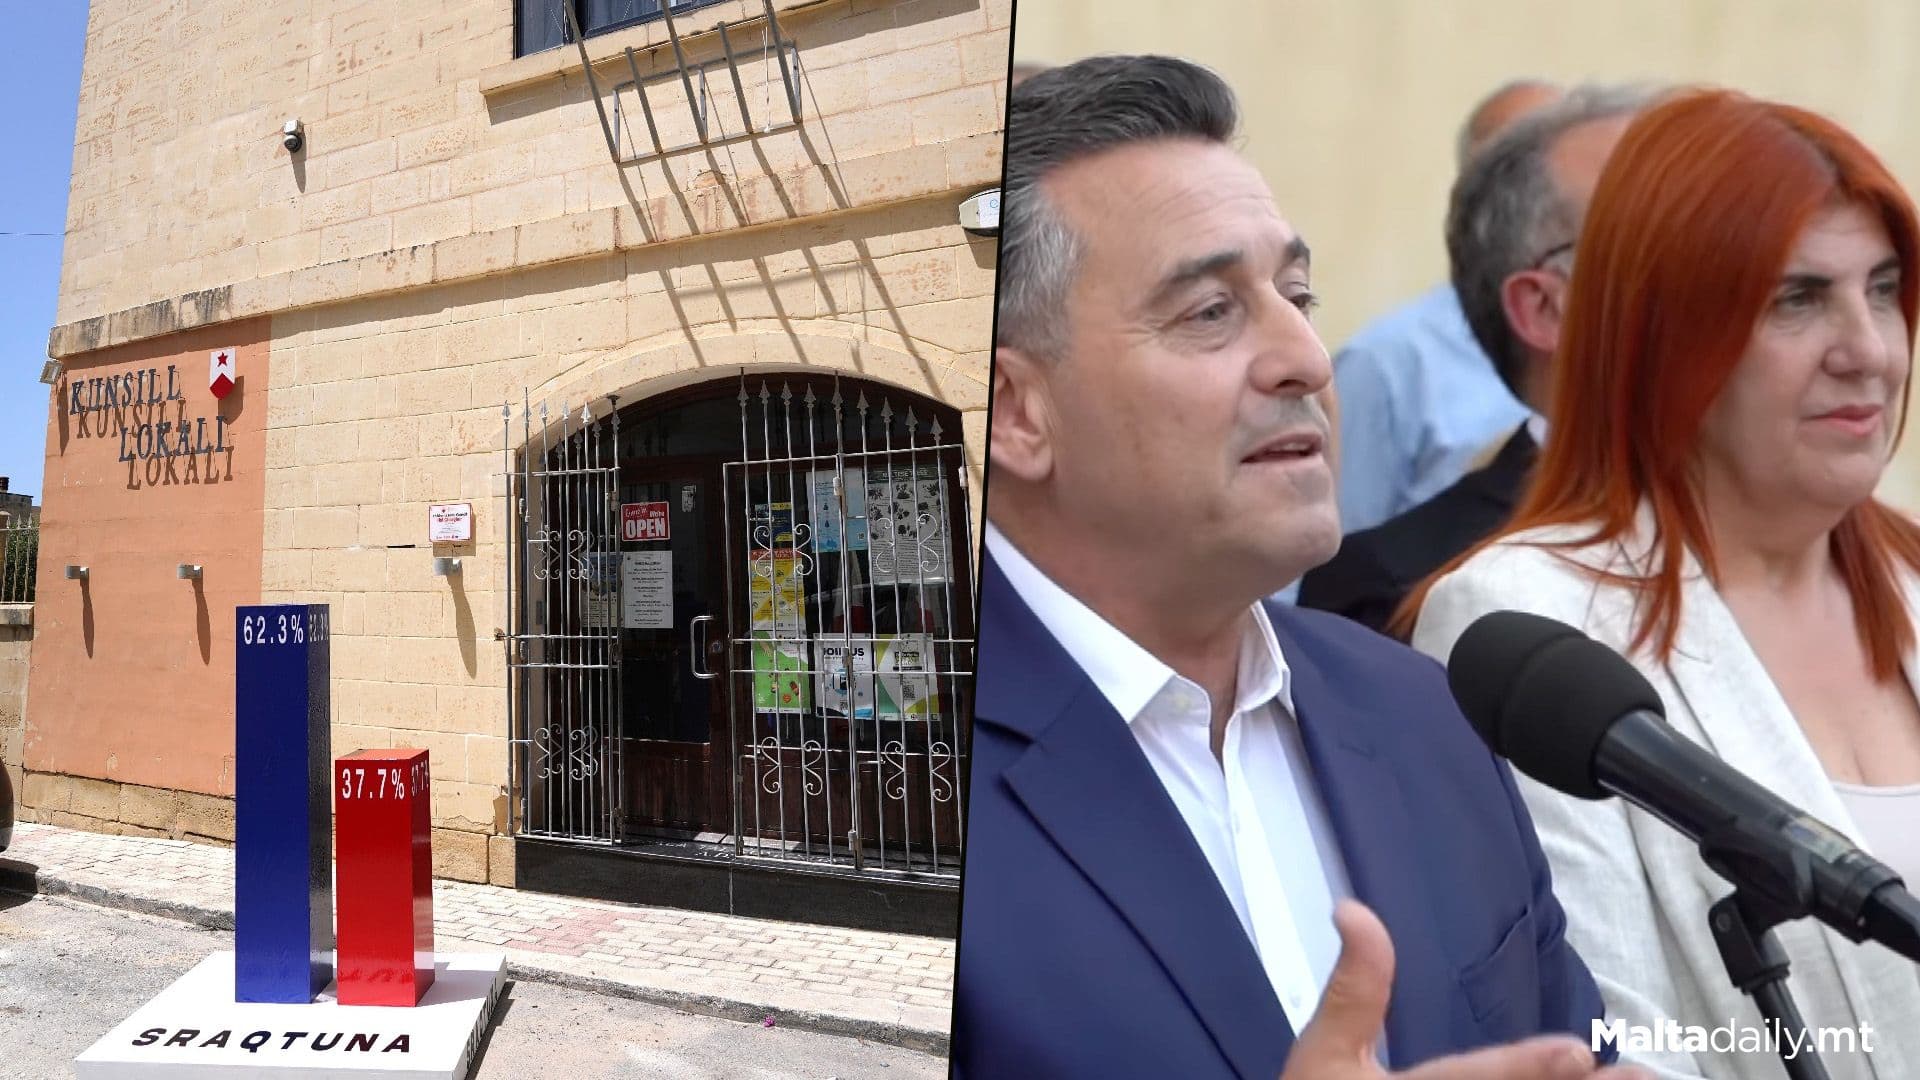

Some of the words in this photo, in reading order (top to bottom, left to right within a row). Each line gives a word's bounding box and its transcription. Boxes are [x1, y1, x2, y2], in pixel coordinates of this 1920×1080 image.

[70, 365, 181, 415] KUNSILL
[119, 416, 227, 462] LOKALI
[625, 518, 666, 539] OPEN
[243, 614, 304, 645] 62.3%
[342, 768, 405, 800] 37.7%
[131, 1028, 410, 1053] SRAQTUNA
